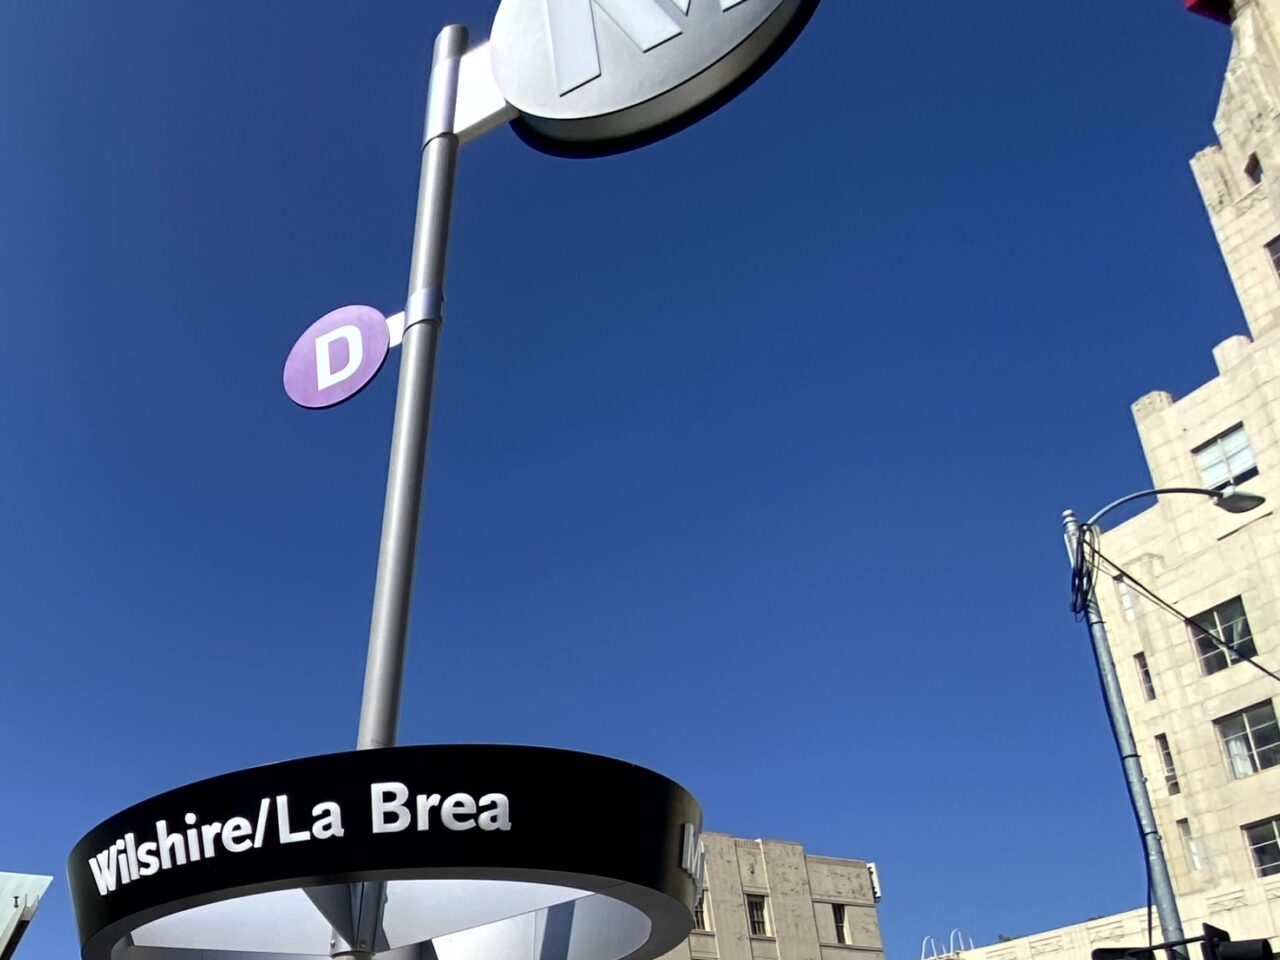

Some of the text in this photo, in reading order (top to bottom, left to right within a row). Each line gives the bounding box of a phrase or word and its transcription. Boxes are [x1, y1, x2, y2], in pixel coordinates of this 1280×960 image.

[314, 323, 364, 391] D
[88, 780, 512, 896] Wilshire/La Brea
